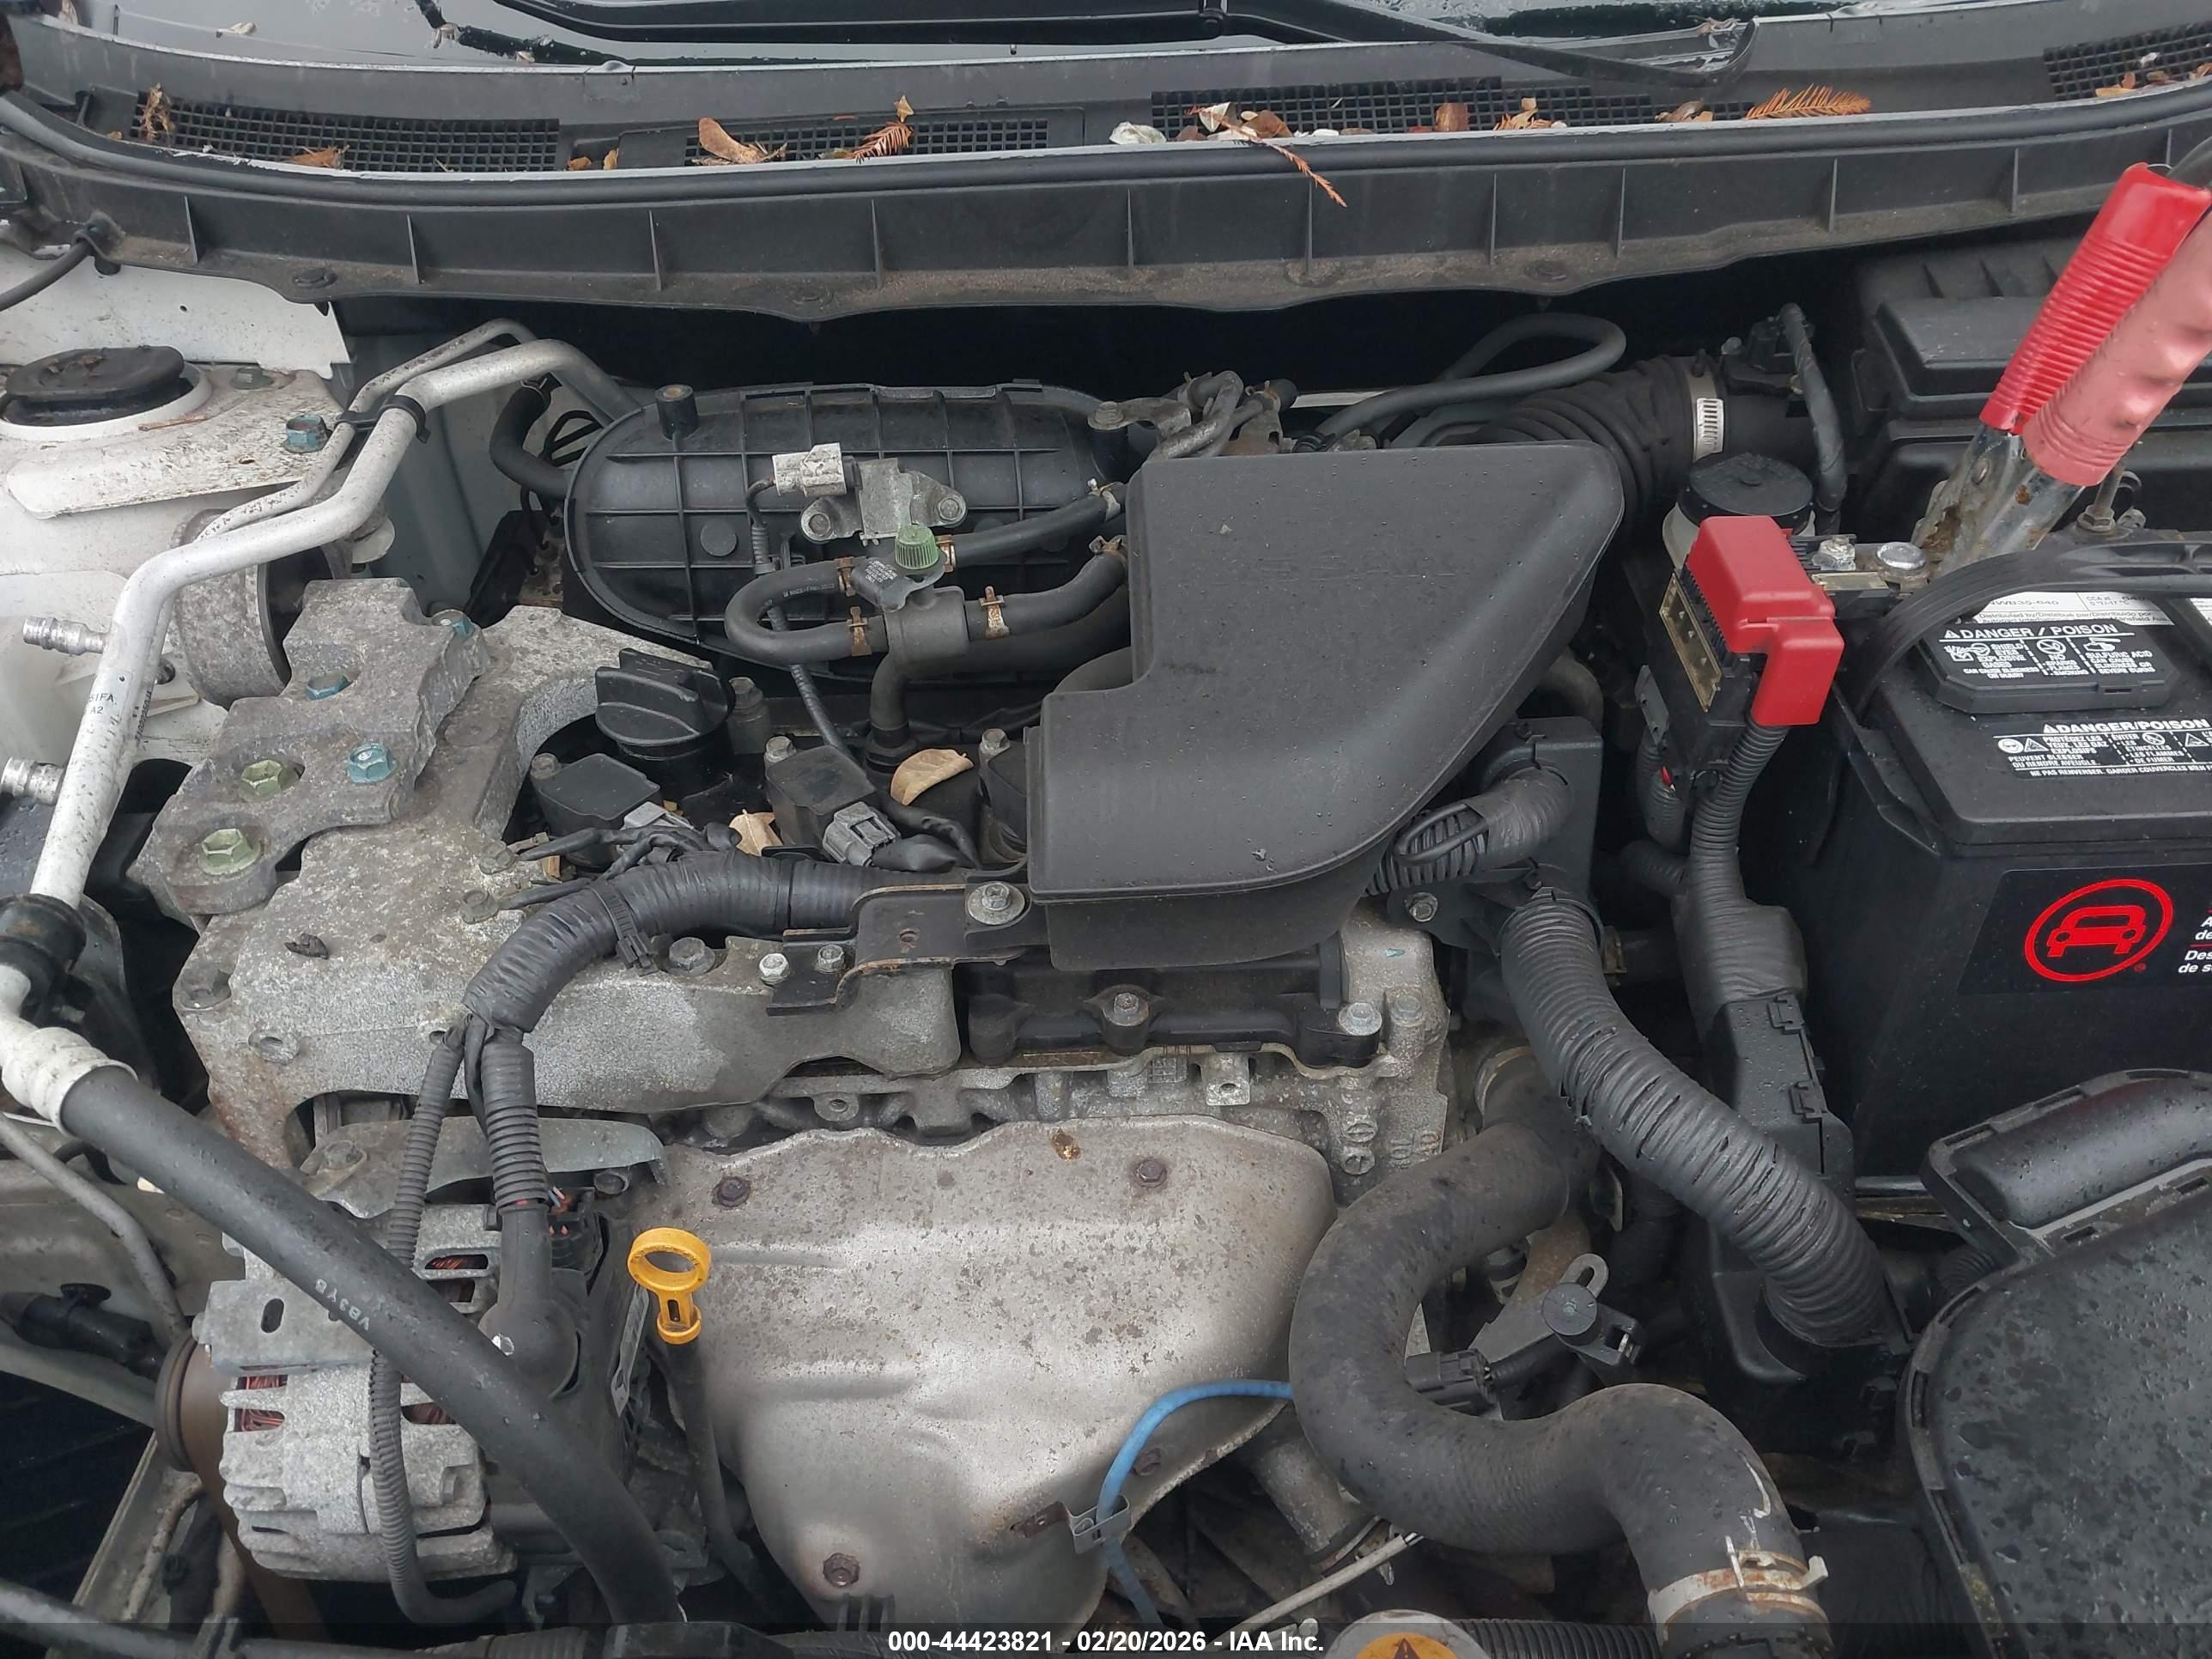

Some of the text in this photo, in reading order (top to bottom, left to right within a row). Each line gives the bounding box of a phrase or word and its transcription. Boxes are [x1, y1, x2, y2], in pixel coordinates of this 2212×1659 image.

[1960, 628, 2034, 638] DANGER
[2050, 623, 2118, 635] POISON
[2056, 719, 2210, 733] DANGER/POISON
[2178, 963, 2198, 973] de
